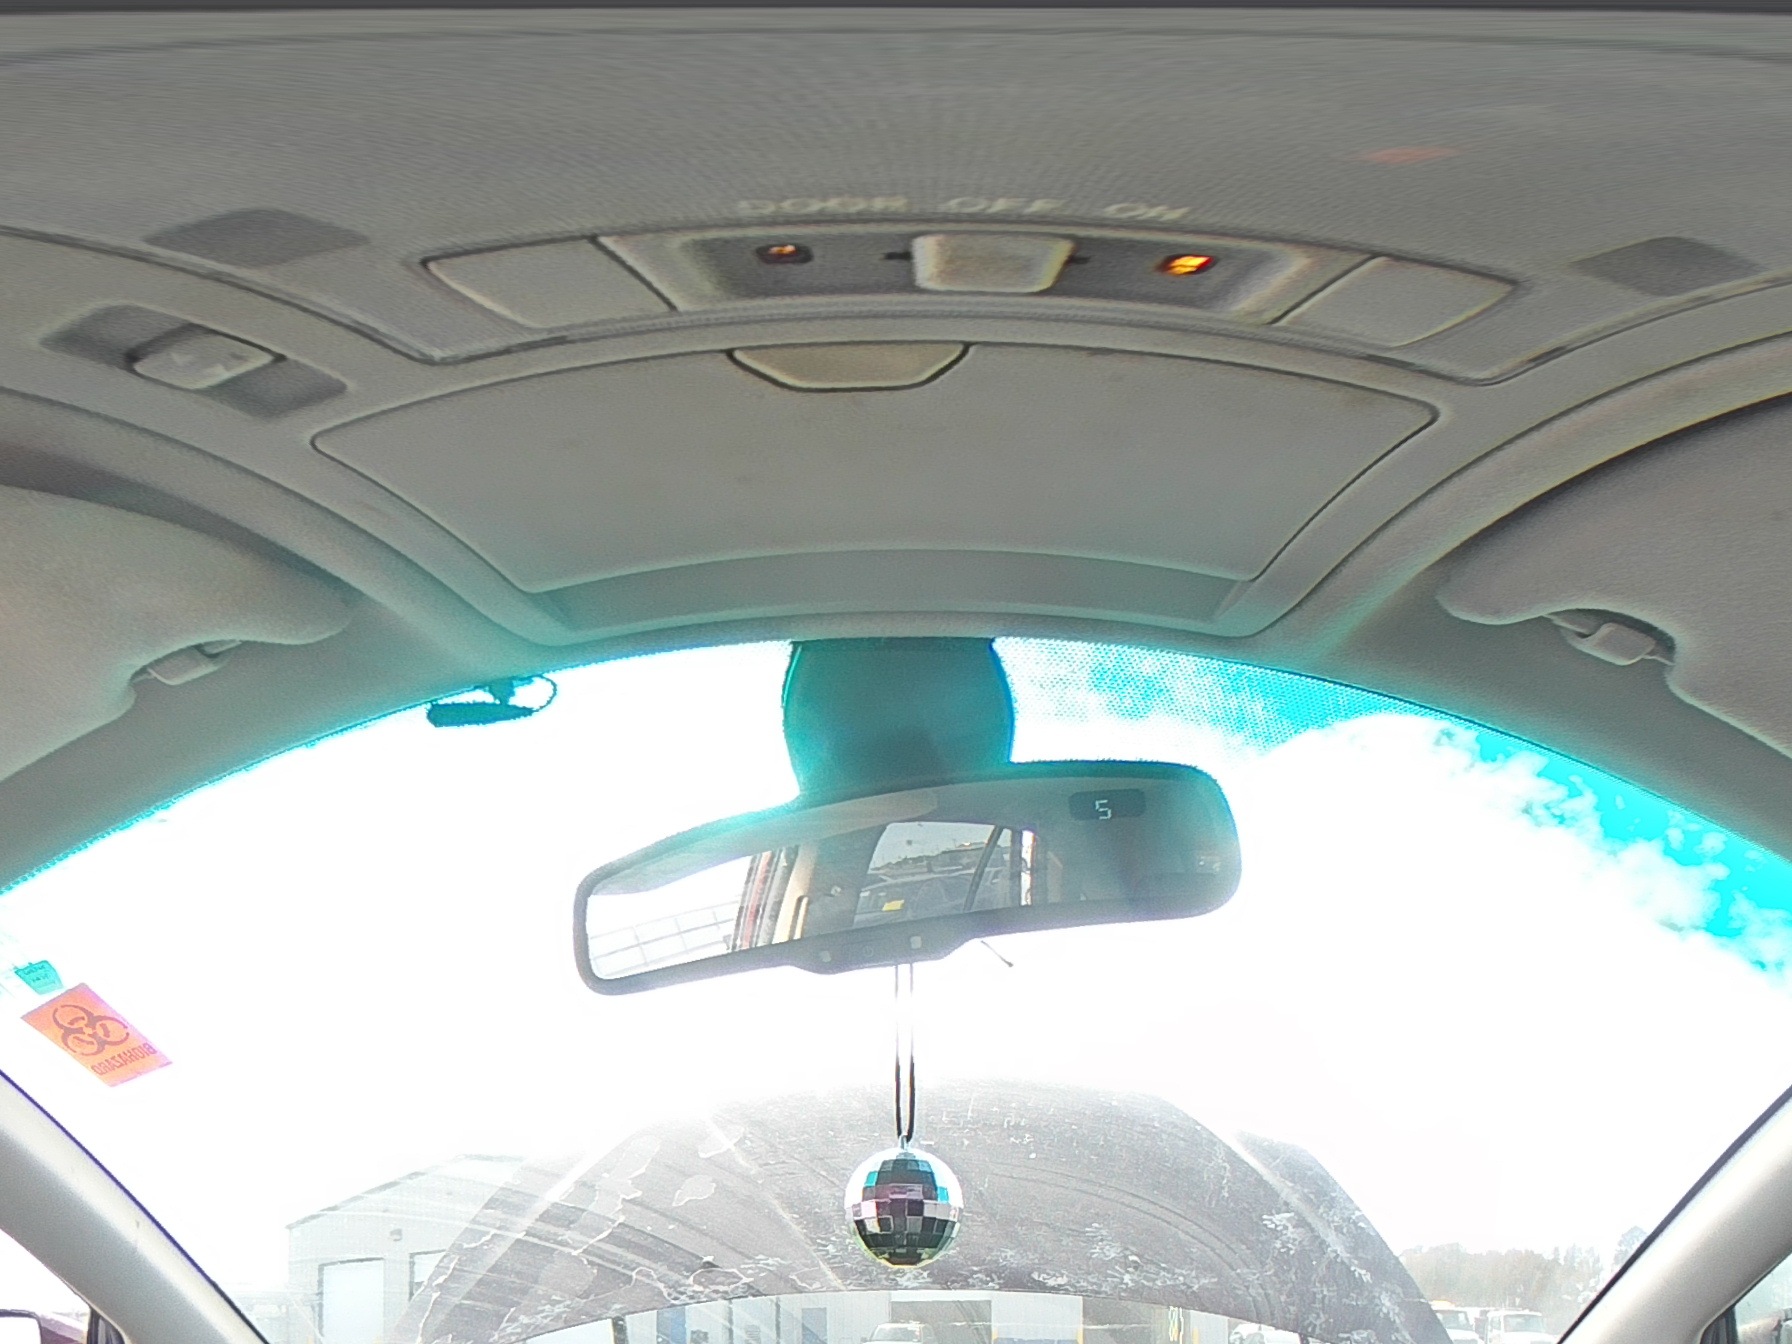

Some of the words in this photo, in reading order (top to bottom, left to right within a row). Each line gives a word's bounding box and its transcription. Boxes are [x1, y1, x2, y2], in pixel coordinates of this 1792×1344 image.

[737, 196, 911, 214] DOOR
[940, 197, 1064, 214] OFF
[1101, 201, 1192, 222] ON
